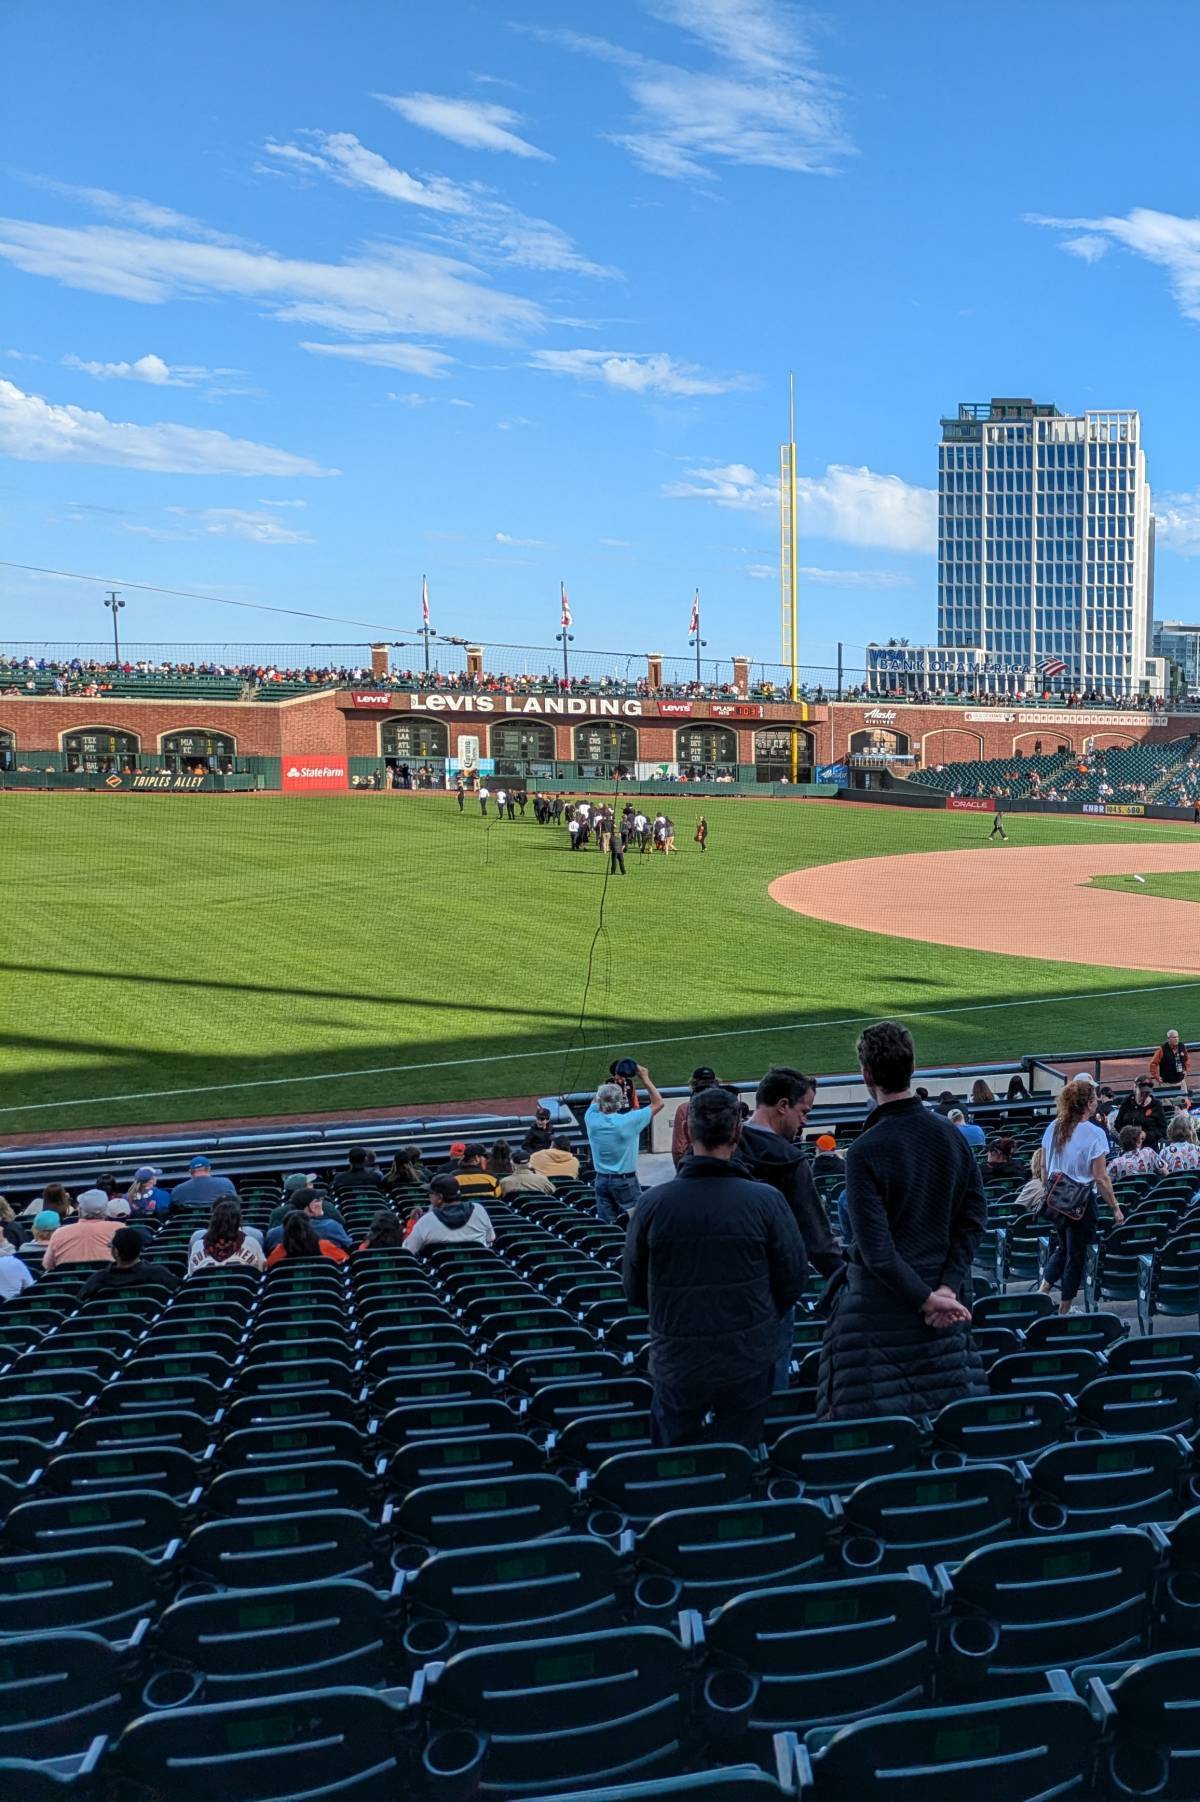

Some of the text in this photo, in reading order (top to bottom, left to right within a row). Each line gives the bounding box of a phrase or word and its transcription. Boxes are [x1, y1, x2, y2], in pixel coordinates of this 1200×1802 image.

[880, 659, 1031, 674] BANK OF AMERICA
[505, 696, 642, 716] LANDING
[864, 708, 897, 720] Alaska
[70, 739, 76, 748] 4
[82, 736, 97, 744] TEX
[168, 742, 174, 750] 4
[180, 738, 193, 746] MIA
[522, 735, 534, 744] 2 4
[84, 744, 97, 752] MIL
[182, 746, 192, 754] KC
[133, 776, 204, 788] TRIPLES ALLEY
[352, 775, 375, 785] 365
[952, 800, 987, 809] ORACLE
[1083, 804, 1105, 813] KNBR
